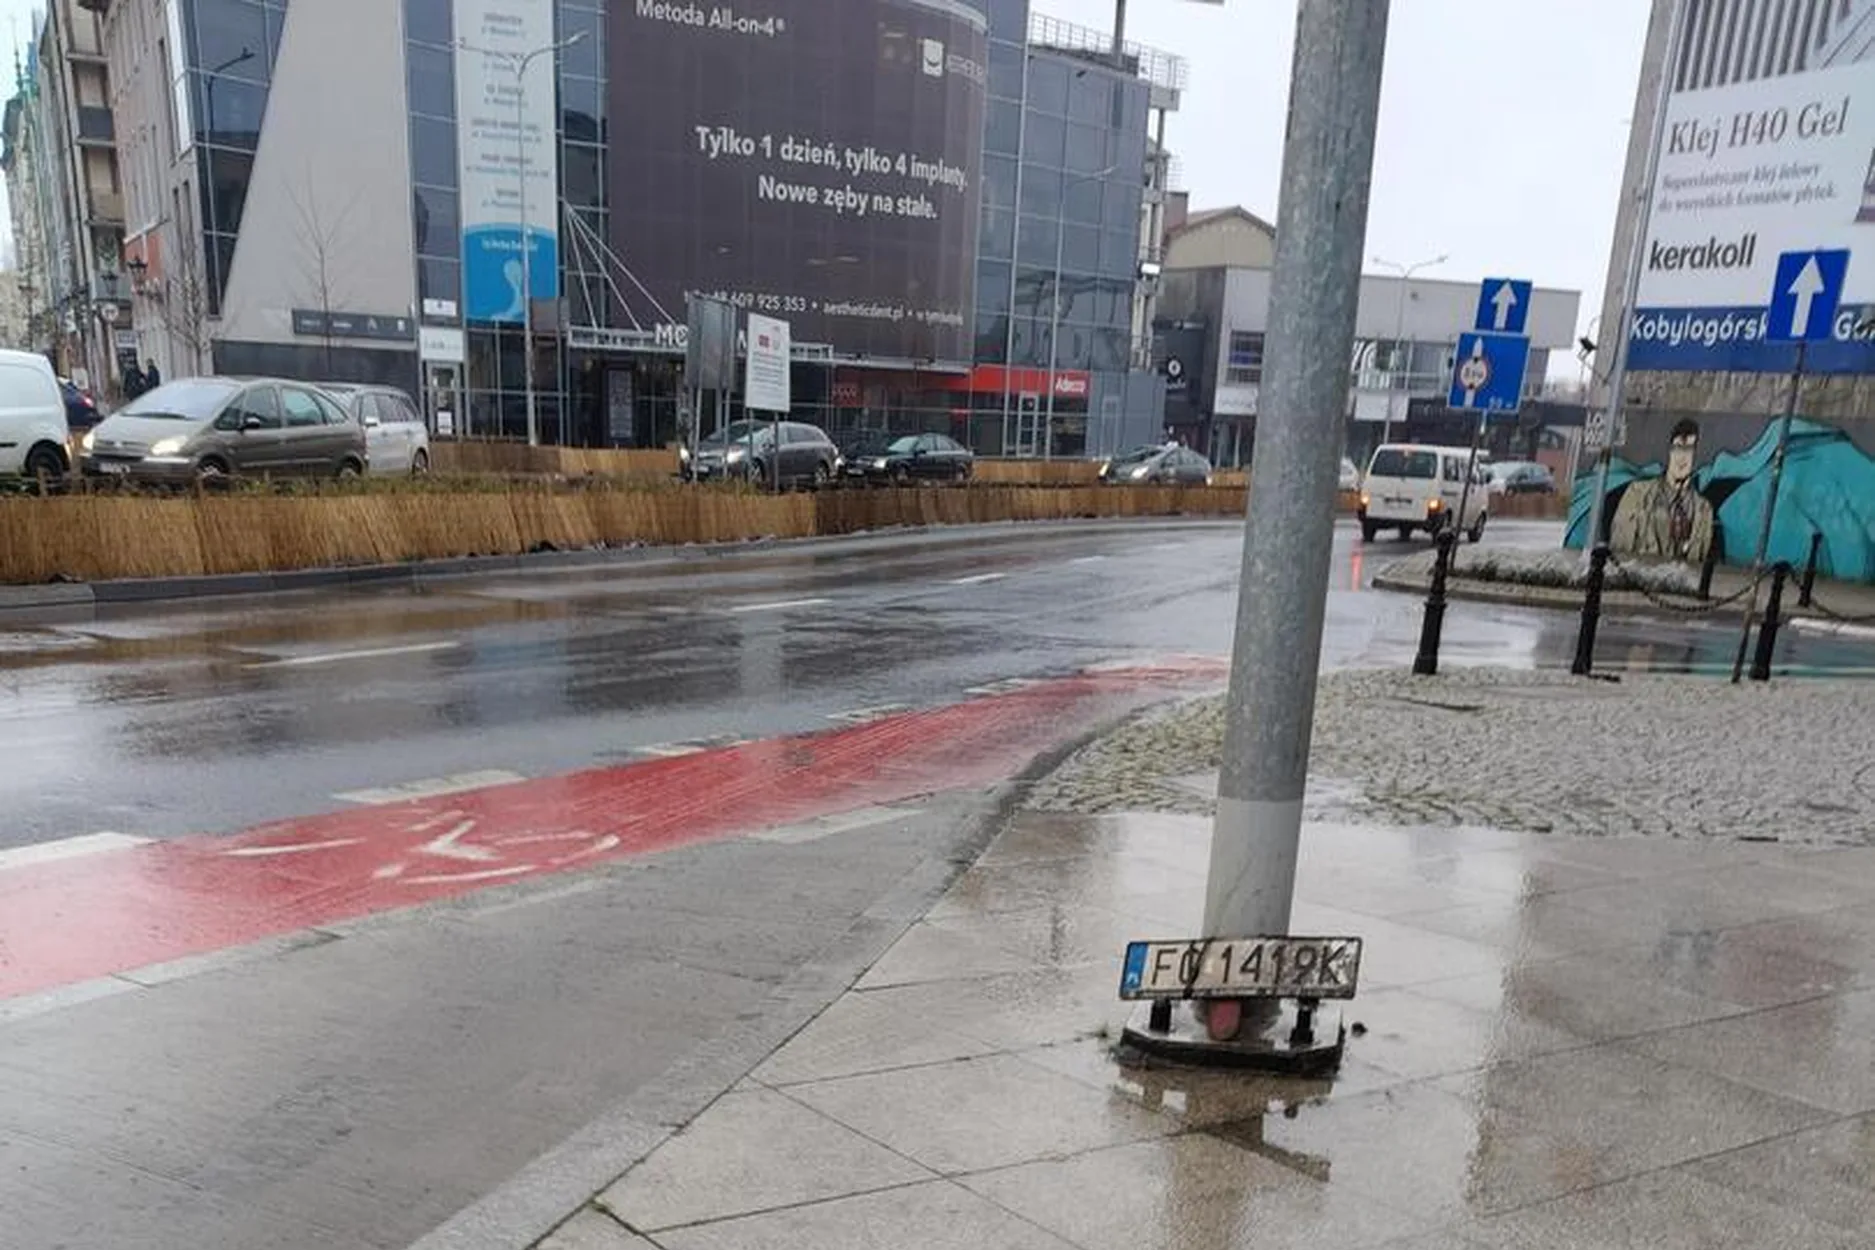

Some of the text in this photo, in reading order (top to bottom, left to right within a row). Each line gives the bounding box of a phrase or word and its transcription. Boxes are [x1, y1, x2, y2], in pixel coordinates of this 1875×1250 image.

[636, 0, 705, 26] Metoda
[1669, 96, 1851, 159] Klej H40 Gel
[696, 126, 755, 159] Tylko
[759, 134, 773, 158] 1
[780, 134, 842, 171] dzień,
[845, 147, 891, 177] tylko
[895, 153, 908, 176] 4
[758, 174, 819, 205] Nowe
[824, 184, 870, 216] zęby
[872, 193, 893, 214] na
[1649, 232, 1757, 272] kerakoll
[757, 293, 780, 311] 925
[783, 295, 807, 313] 353
[1631, 310, 1769, 347] Kobylogórsk
[1220, 942, 1346, 985] 1419K
